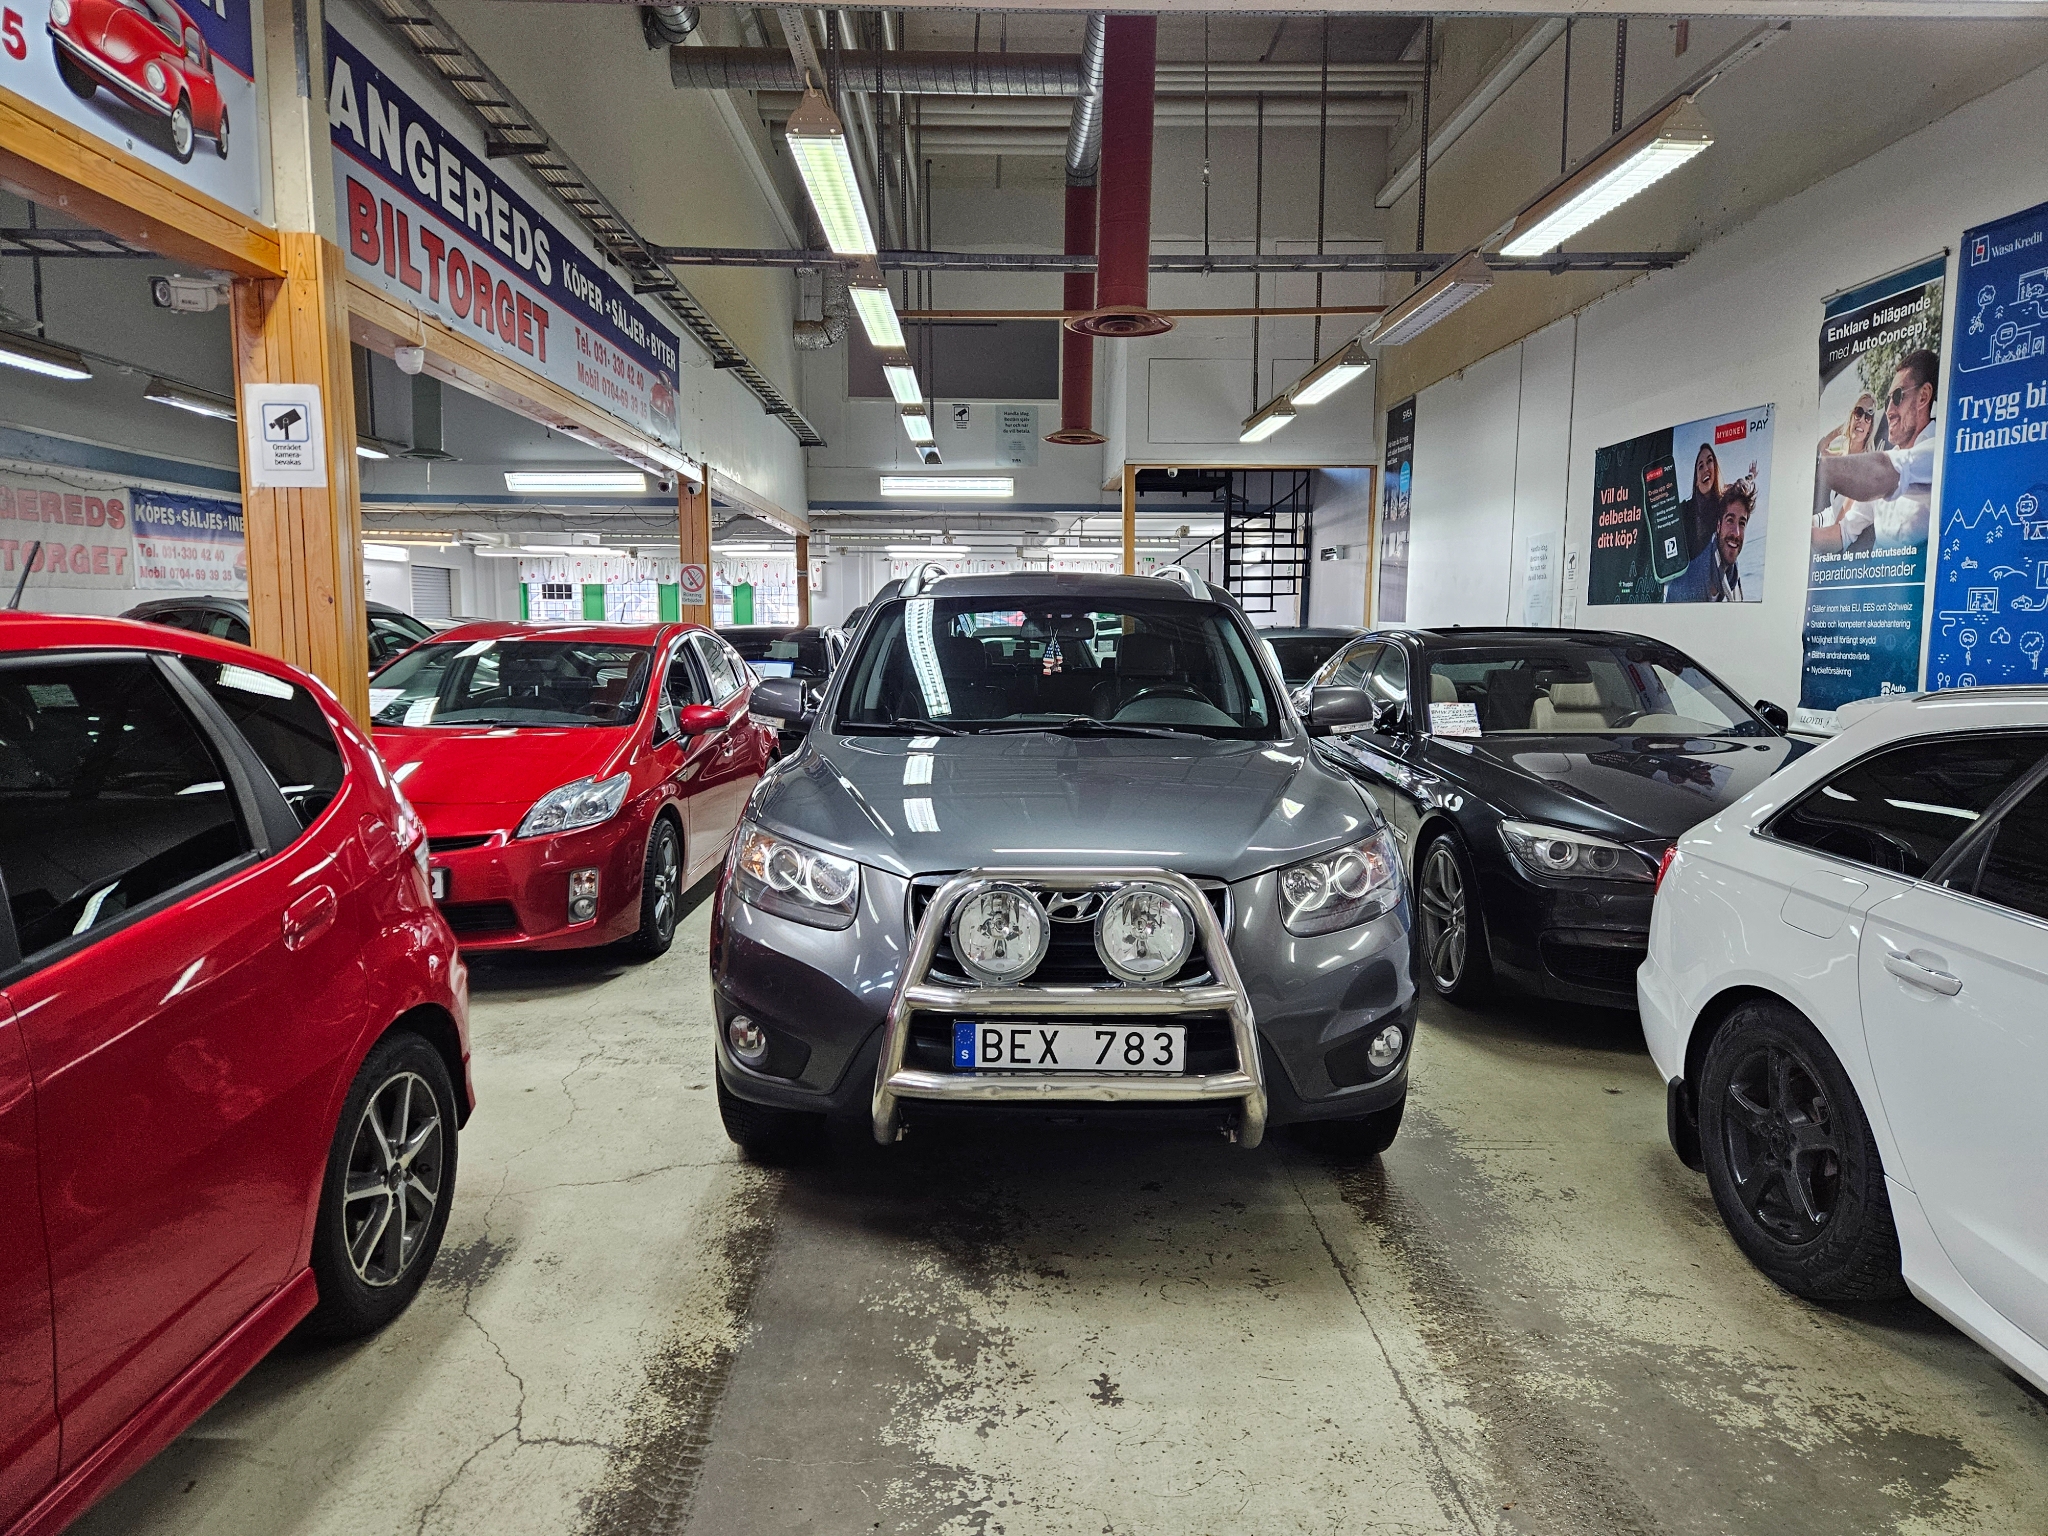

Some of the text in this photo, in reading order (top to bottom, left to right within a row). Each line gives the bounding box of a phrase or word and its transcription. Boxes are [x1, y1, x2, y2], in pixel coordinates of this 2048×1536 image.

[329, 55, 552, 286] ANGEREDS
[1991, 231, 2043, 258] Wasa Kredit
[346, 175, 550, 364] BILTORGET
[562, 258, 676, 372] KÖPER SÄLJER BYTER
[1827, 296, 1931, 342] Enklare bilägande
[1829, 318, 1929, 362] med AutoConcept
[575, 326, 592, 358] Tel.
[612, 353, 625, 379] 330
[626, 363, 635, 386] 42
[577, 360, 600, 392] Mobil
[1958, 379, 2048, 424] Trygg bi
[1716, 418, 1769, 440] MYMONEY PAY
[1953, 417, 2048, 454] finansier
[272, 443, 302, 451] Området
[274, 451, 302, 459] kamera-
[1601, 486, 1629, 505] Vill du
[135, 502, 175, 526] KÖPES
[181, 508, 222, 530] SÄLJES
[1599, 505, 1642, 527] delbetala
[1597, 528, 1638, 549] ditt köp?
[0, 539, 128, 576] TORGET
[138, 543, 158, 558] Tel.
[200, 548, 211, 561] 42
[214, 550, 225, 562] 40
[1813, 545, 1918, 563] Försäkra dig mot oförutsedda
[140, 566, 232, 581] Mobil 0704-69 39 35
[1811, 561, 1917, 584] reparationskostnader
[1811, 602, 1913, 613] Gäller inom hela EU, EES och Schweiz
[1810, 619, 1911, 630] Snabb och kompetent skadehantering
[1811, 636, 1833, 646] Möjlighet
[1859, 636, 1877, 646] skydd
[1826, 651, 1870, 661] andrahandsvärde
[1811, 665, 1852, 678] Nyckelförsäkring
[1890, 683, 1907, 693] Auto
[961, 1050, 970, 1060] S
[981, 1028, 1174, 1066] BEX 783
